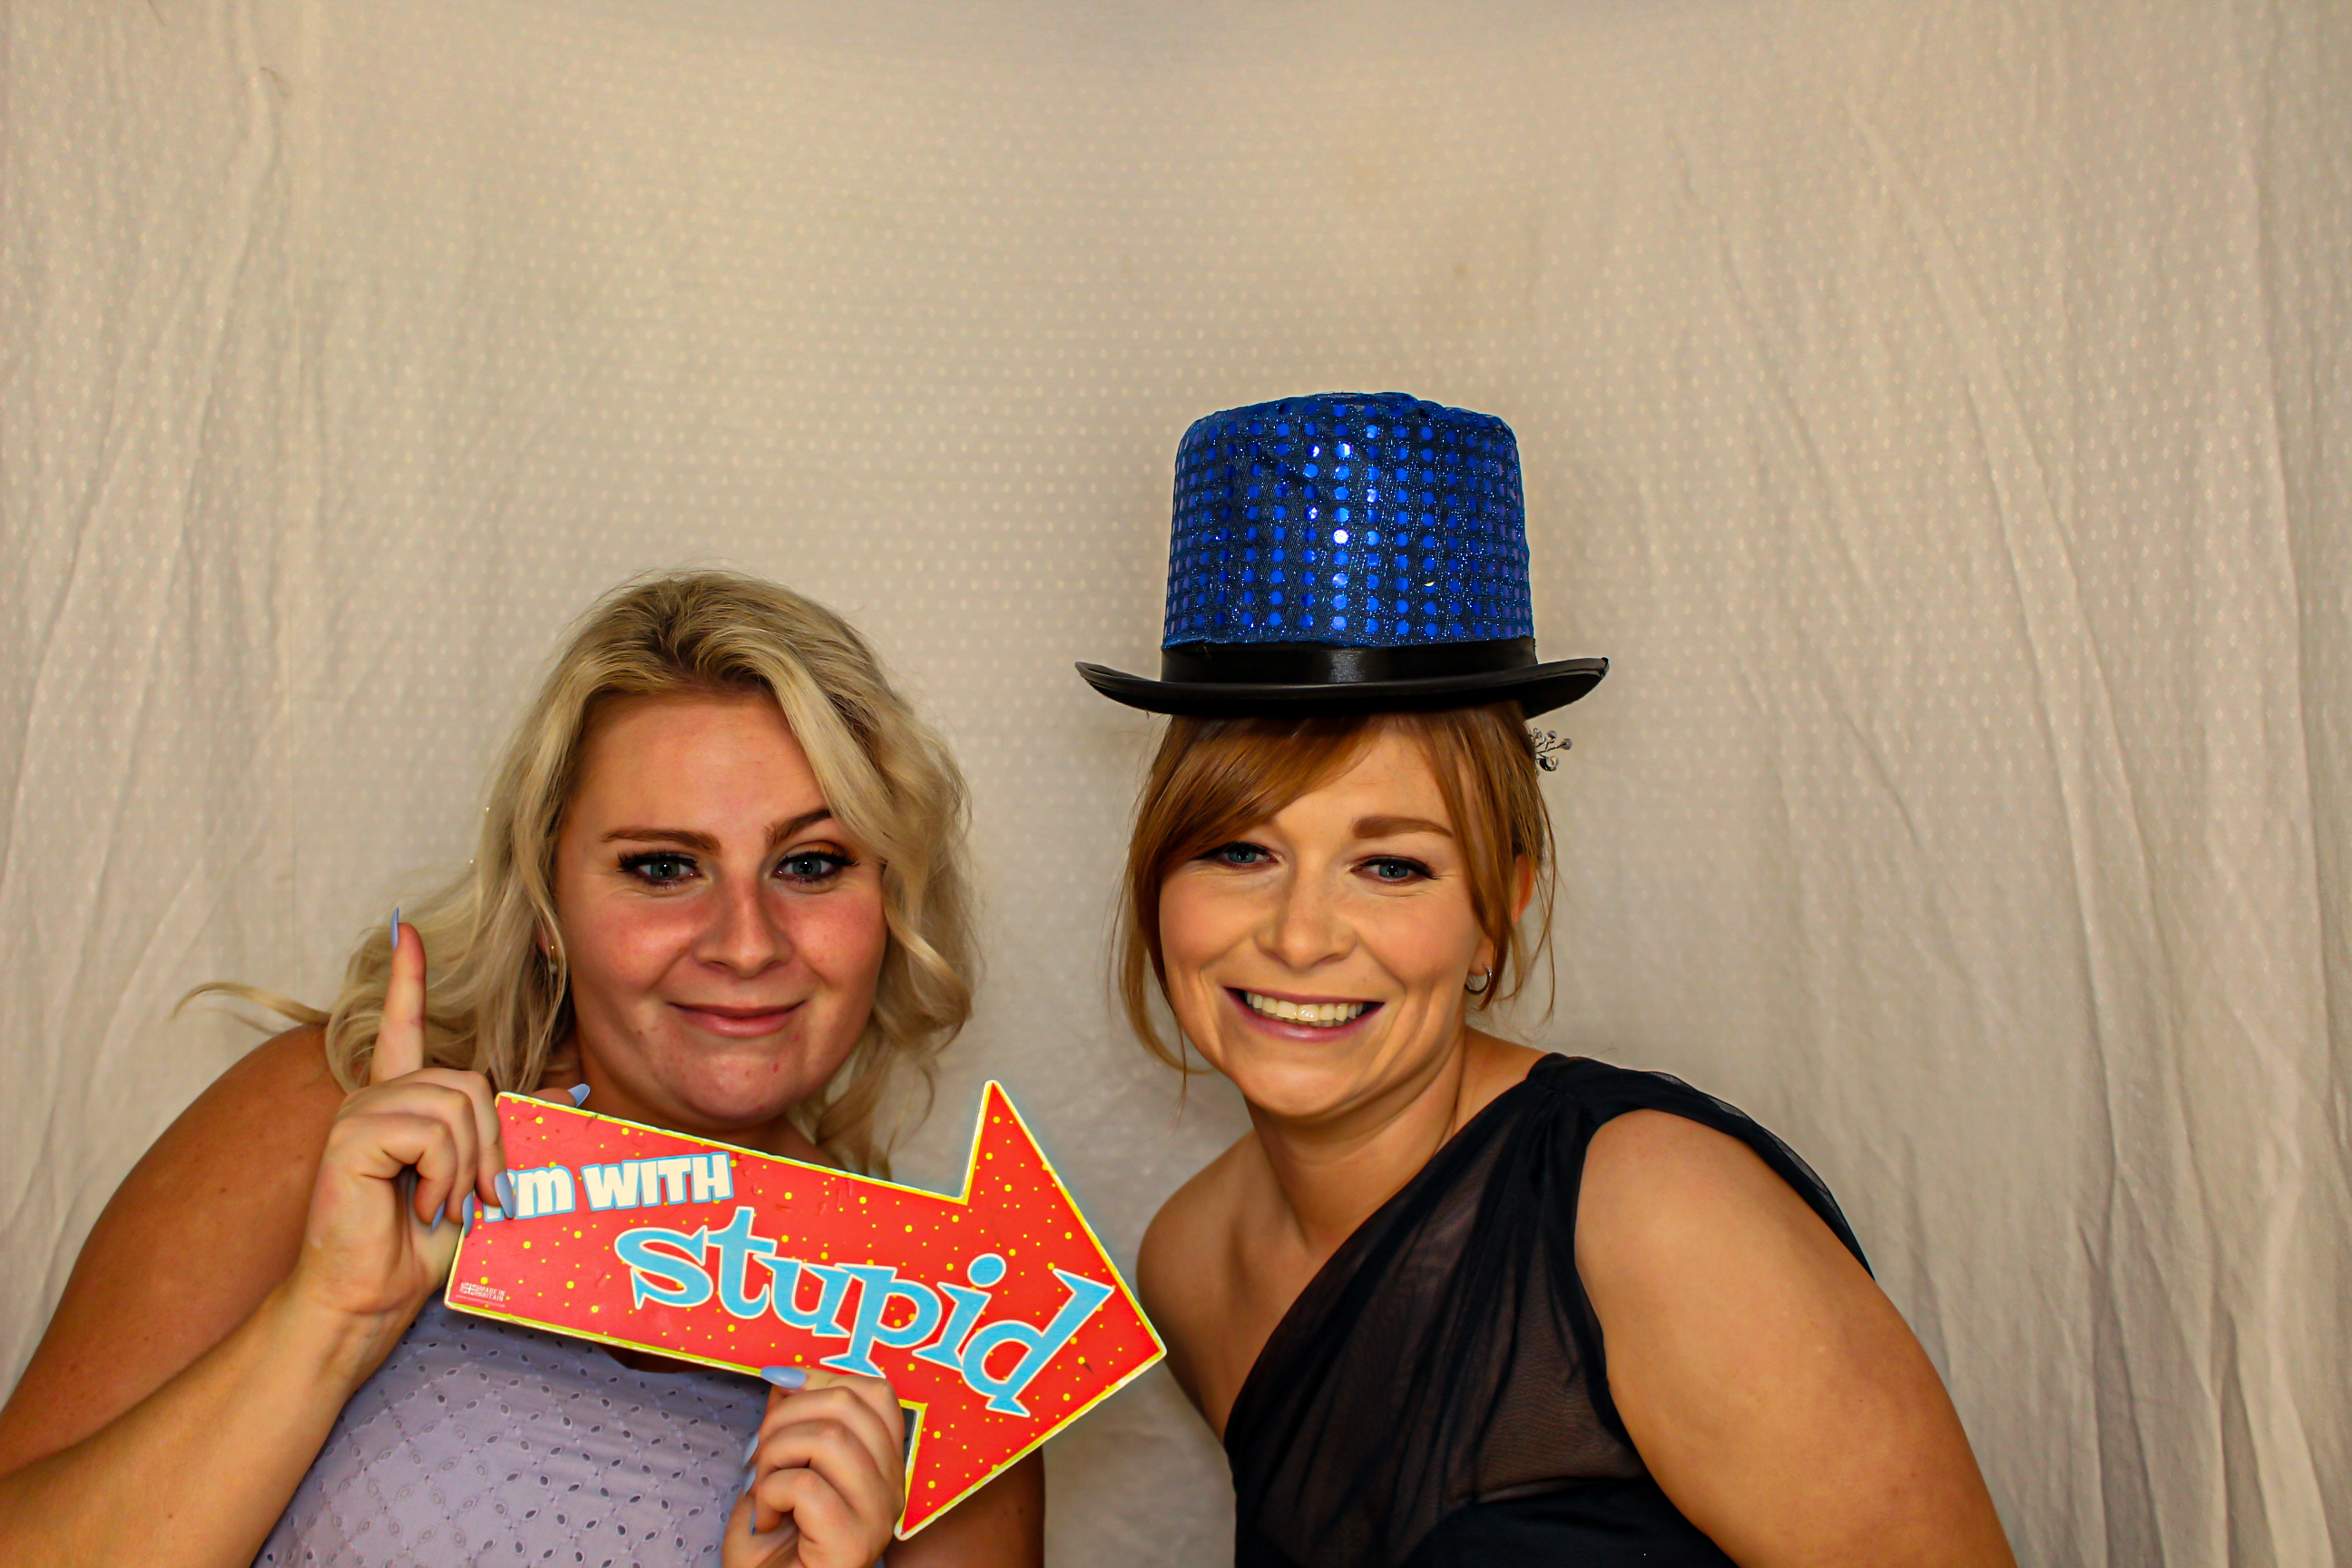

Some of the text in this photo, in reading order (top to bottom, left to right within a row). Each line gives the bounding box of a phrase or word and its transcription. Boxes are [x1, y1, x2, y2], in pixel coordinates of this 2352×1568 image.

[581, 1152, 733, 1210] WITH
[477, 1291, 504, 1302] BRITAIN
[479, 1286, 496, 1295] MADE
[614, 1207, 1114, 1416] stupid
